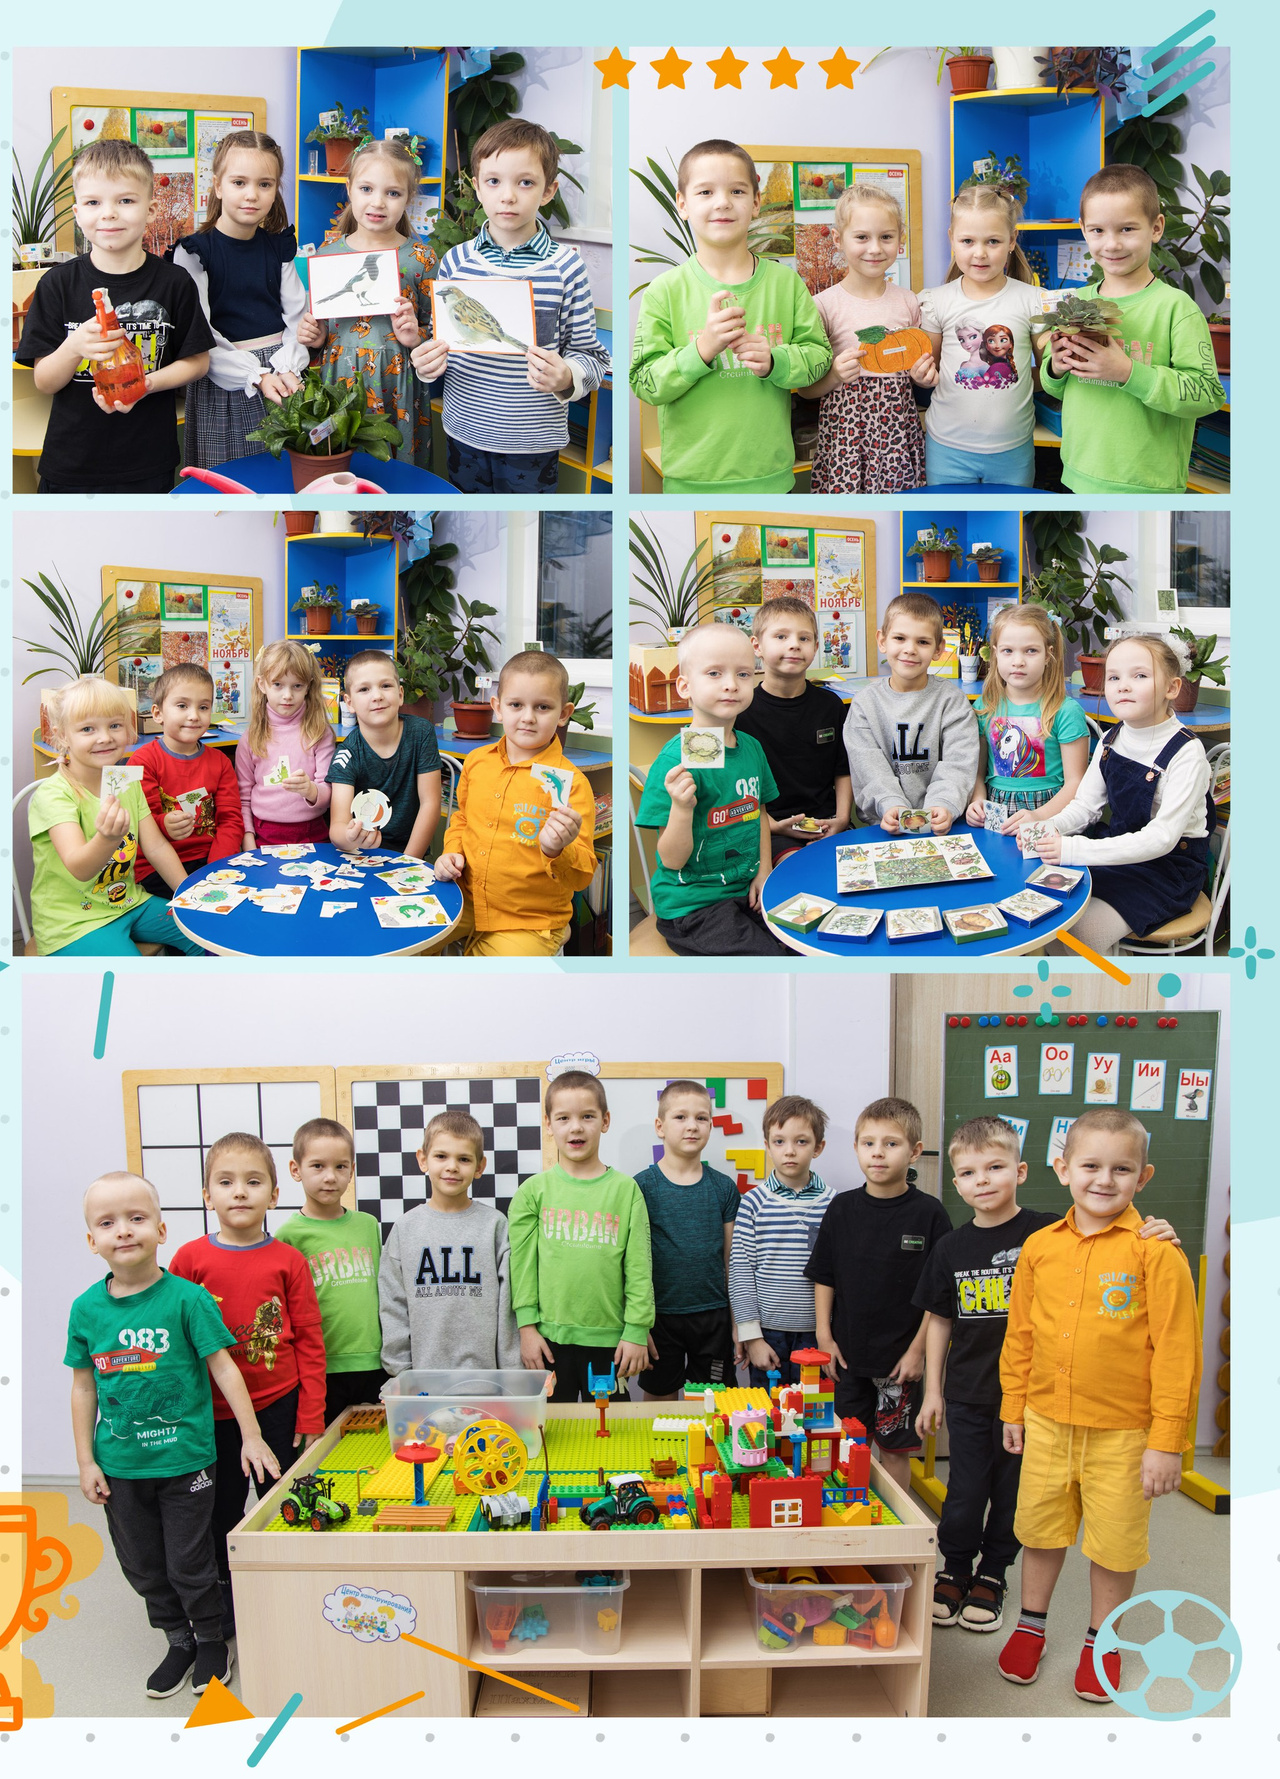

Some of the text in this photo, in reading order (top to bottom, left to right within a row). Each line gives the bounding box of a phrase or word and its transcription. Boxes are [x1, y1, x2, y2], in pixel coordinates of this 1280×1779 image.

[820, 598, 861, 608] НОЯБРЬ
[213, 648, 249, 659] НОЯБРЬ
[989, 1049, 1012, 1063] Аа
[1093, 1056, 1114, 1074] Уу
[1138, 1063, 1160, 1077] Ии
[1180, 1072, 1209, 1087] Ыы
[1056, 1120, 1073, 1134] Н
[542, 1206, 620, 1247] URBAN
[414, 1246, 482, 1287] ALL
[415, 1285, 482, 1298] ALL ABOUT ME
[960, 1277, 1014, 1312] CHIL
[118, 1328, 170, 1353] 983
[136, 1426, 178, 1440] MIGHTY
[189, 1478, 213, 1493] adidas
[341, 1586, 413, 1615] Центр конструирования
